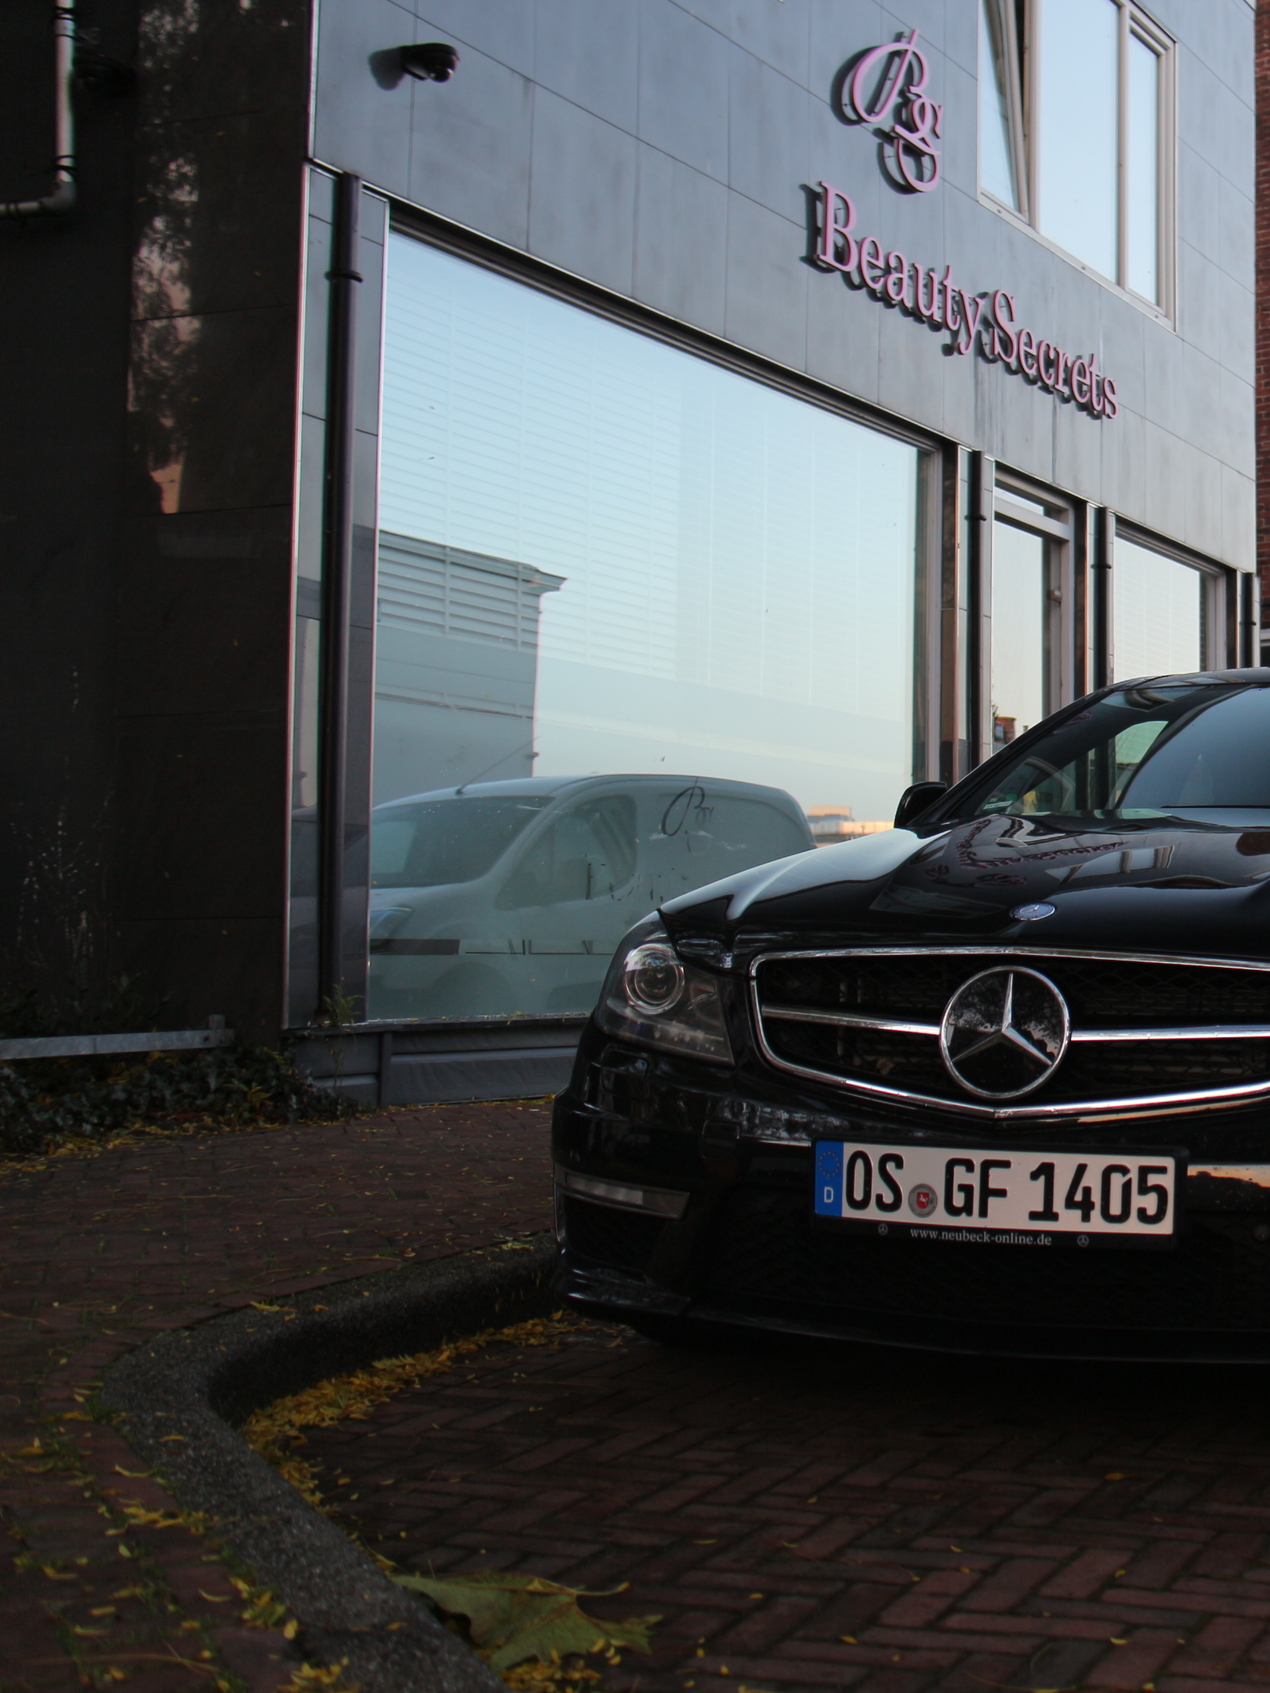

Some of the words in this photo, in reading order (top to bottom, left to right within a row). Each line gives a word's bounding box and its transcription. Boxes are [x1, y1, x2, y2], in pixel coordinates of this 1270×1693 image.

[816, 181, 985, 356] Beauty
[990, 289, 1119, 419] Secrets
[823, 1186, 834, 1204] D
[845, 1149, 905, 1213] OS
[944, 1157, 1012, 1218] GF
[1028, 1161, 1169, 1225] 1405
[910, 1227, 1052, 1246] www.neubeck-online.de
